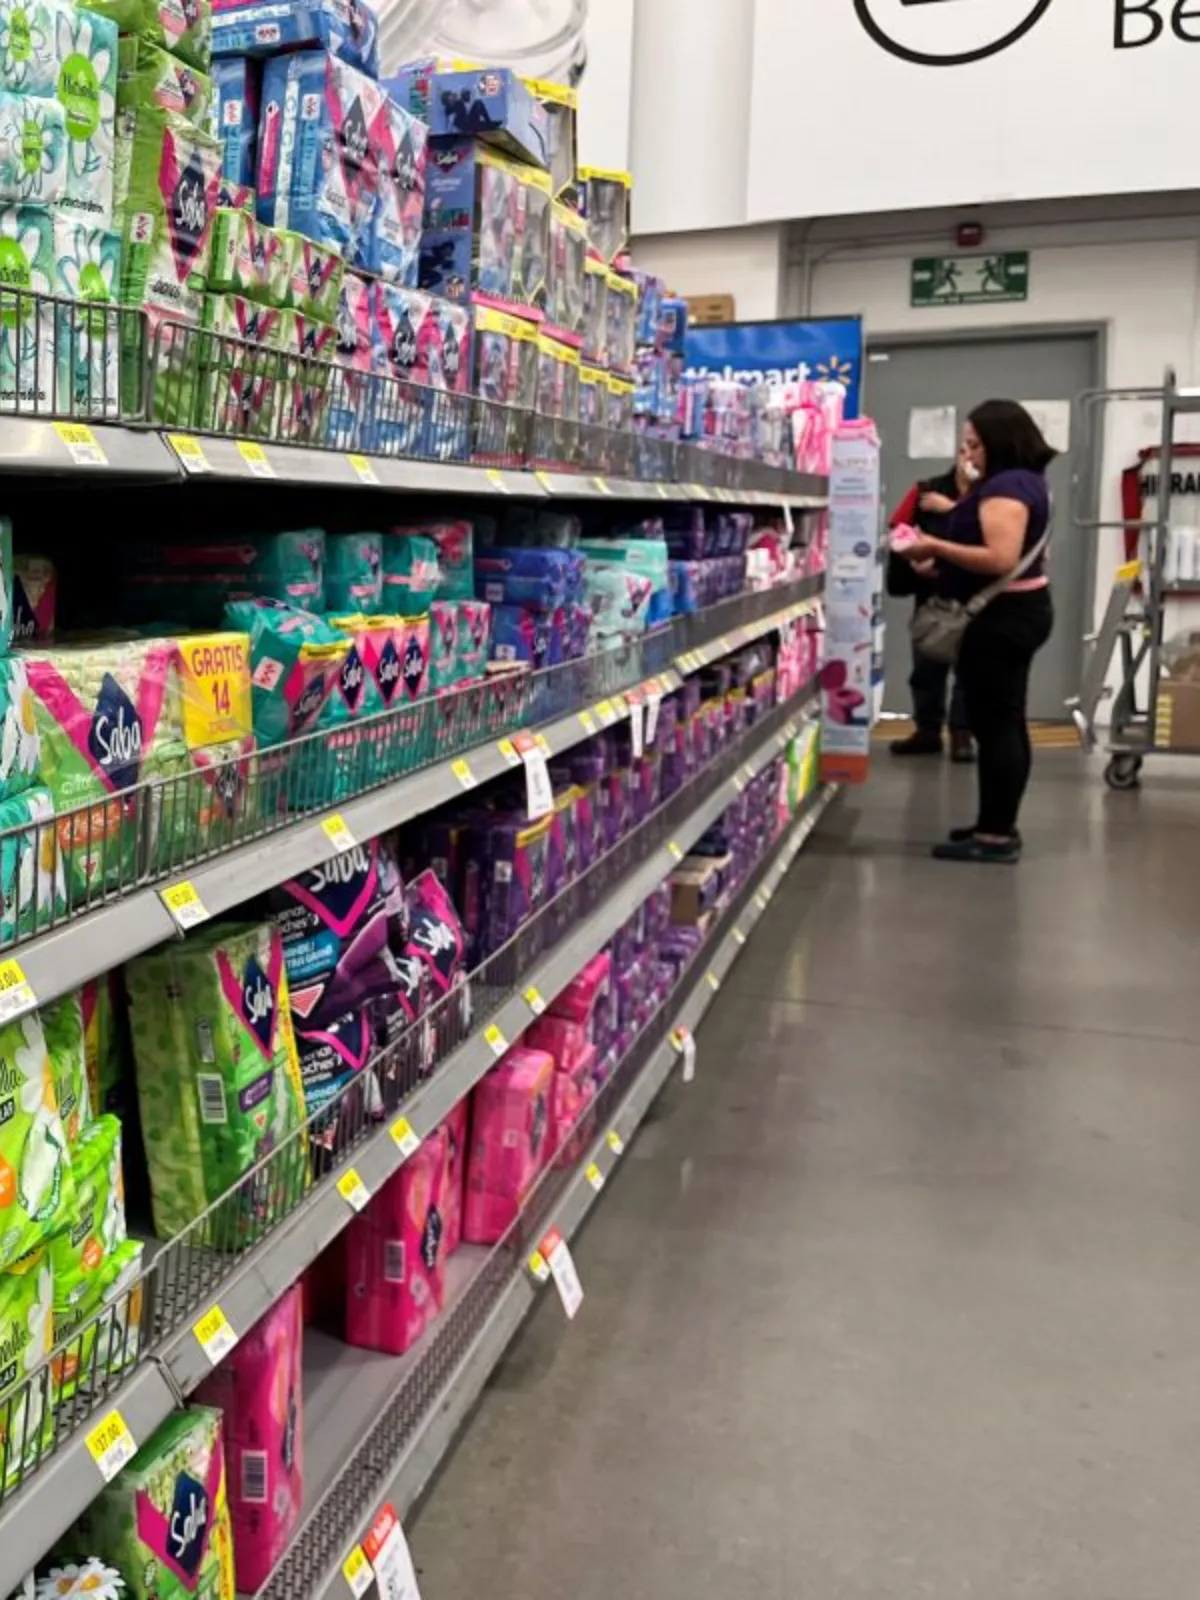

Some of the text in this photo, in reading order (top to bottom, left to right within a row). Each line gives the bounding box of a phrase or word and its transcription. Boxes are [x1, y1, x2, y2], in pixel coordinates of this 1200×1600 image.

[192, 644, 244, 678] GRATIS
[211, 679, 231, 716] 14
[96, 706, 141, 765] Saba
